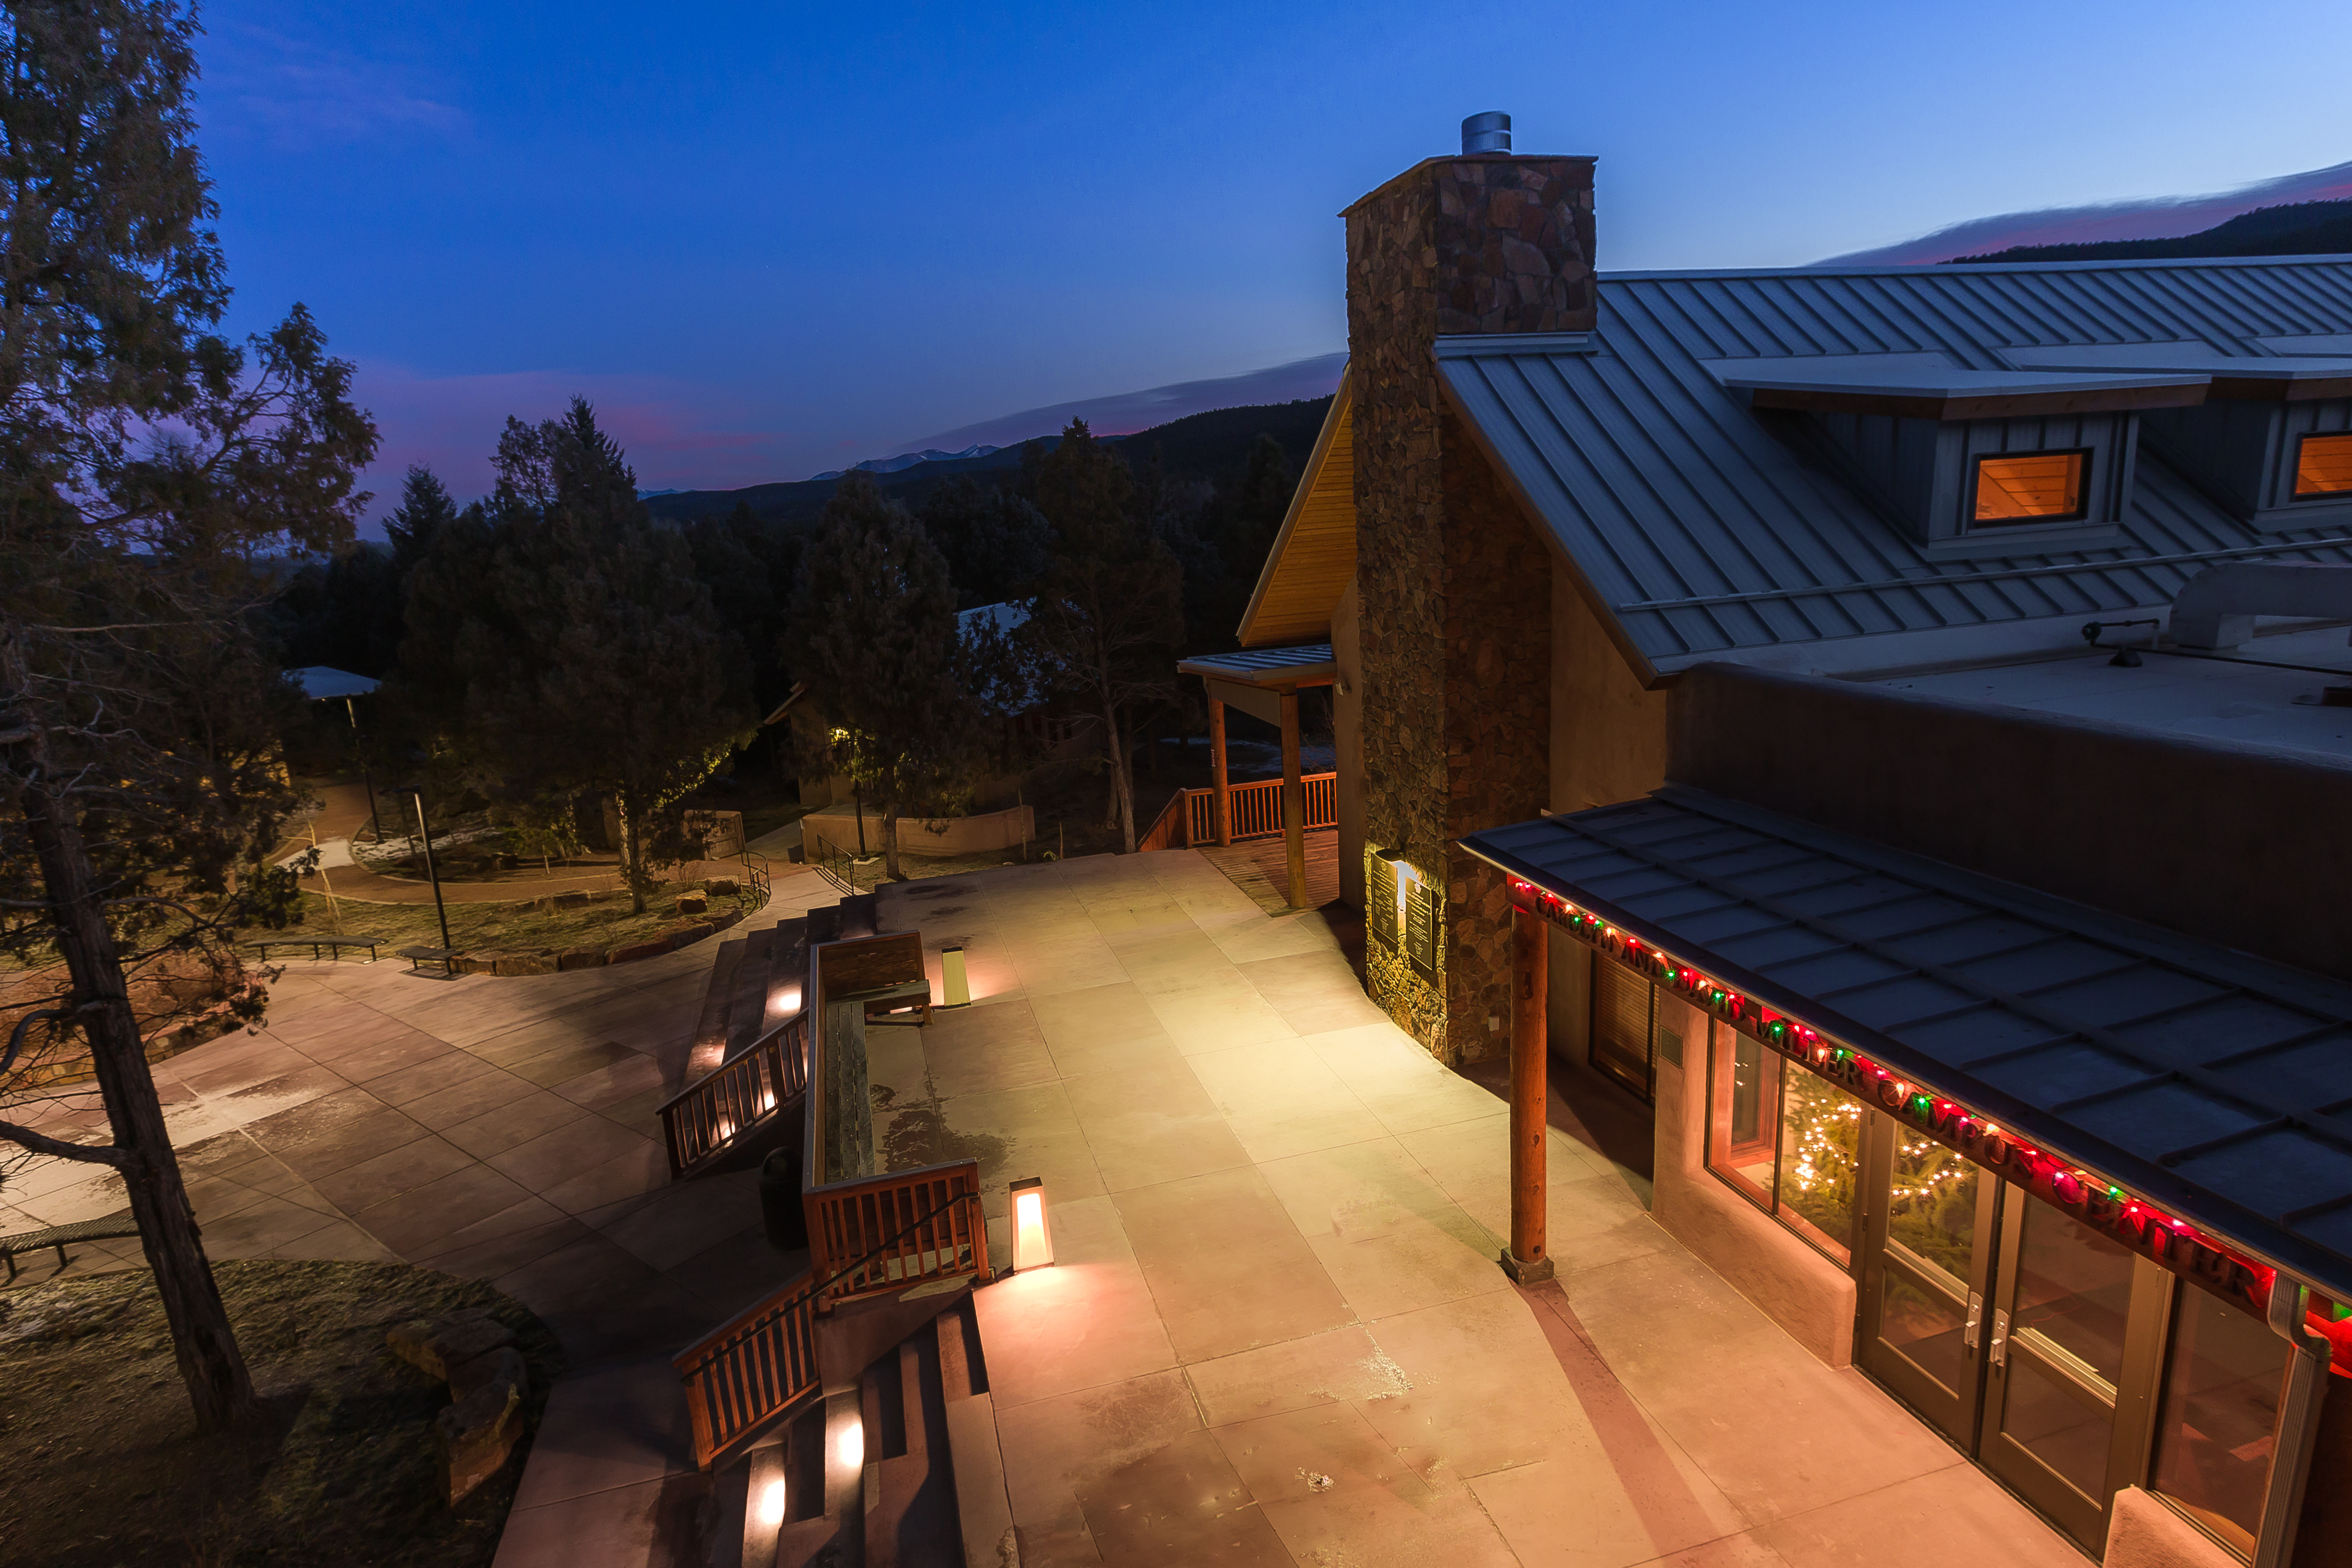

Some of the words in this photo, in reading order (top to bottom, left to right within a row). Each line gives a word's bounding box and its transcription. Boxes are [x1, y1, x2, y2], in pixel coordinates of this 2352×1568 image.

[1620, 941, 1666, 979] AND
[1754, 1018, 1868, 1091] MILLER
[1877, 1079, 2034, 1180] CAMPUS
[2052, 1170, 2266, 1309] CENTER
